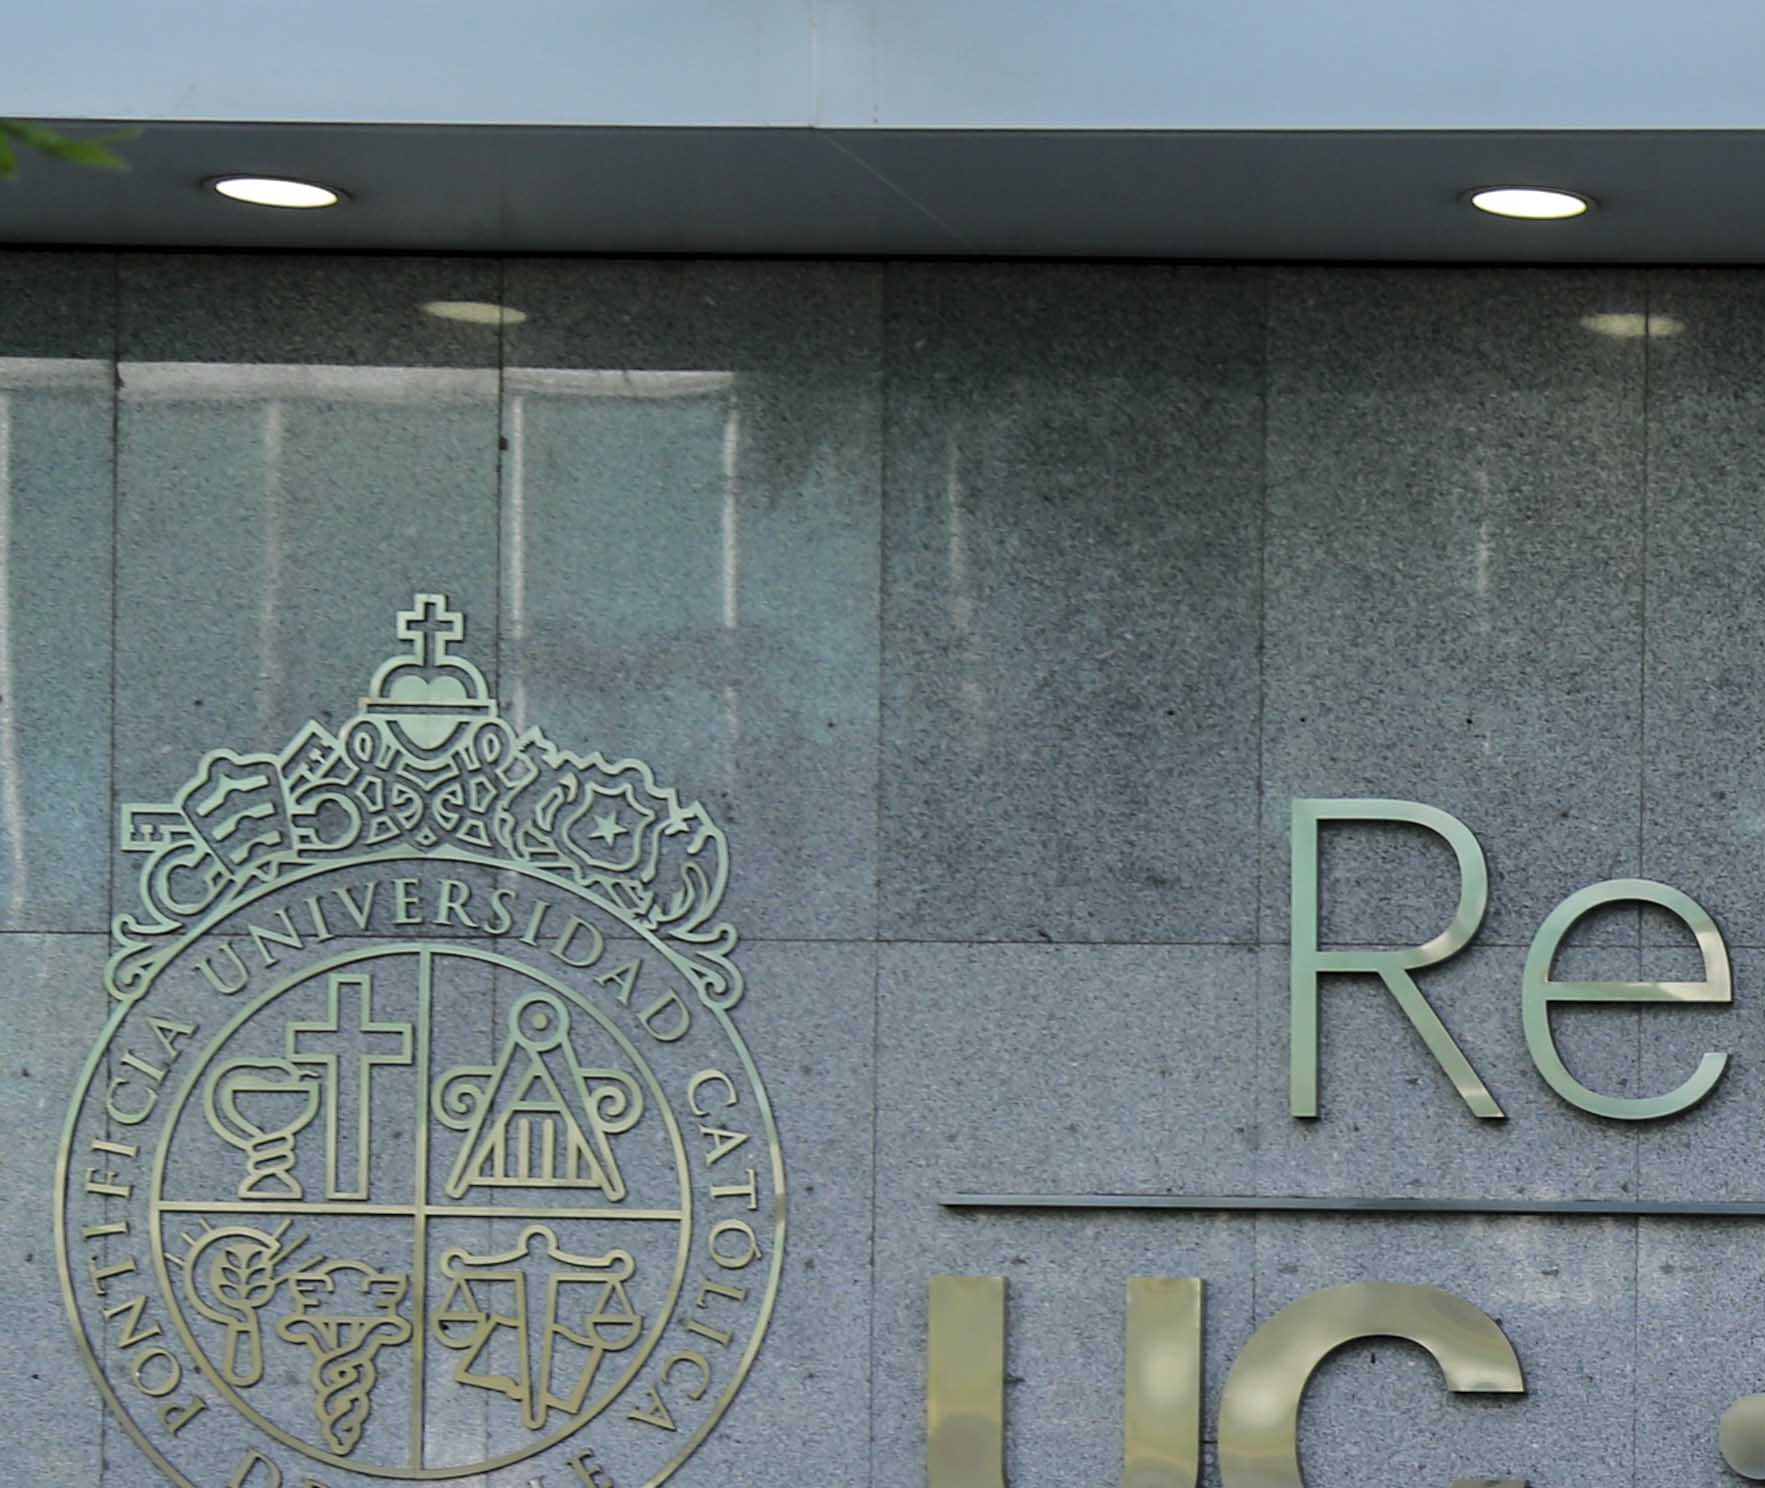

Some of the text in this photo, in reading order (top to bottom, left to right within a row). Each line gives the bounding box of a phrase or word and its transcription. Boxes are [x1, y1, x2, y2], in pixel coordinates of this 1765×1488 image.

[82, 1014, 209, 1438] PONTIFICIA
[194, 877, 692, 1044] UNIVERSIDAD
[626, 1067, 762, 1432] CATÓLICA
